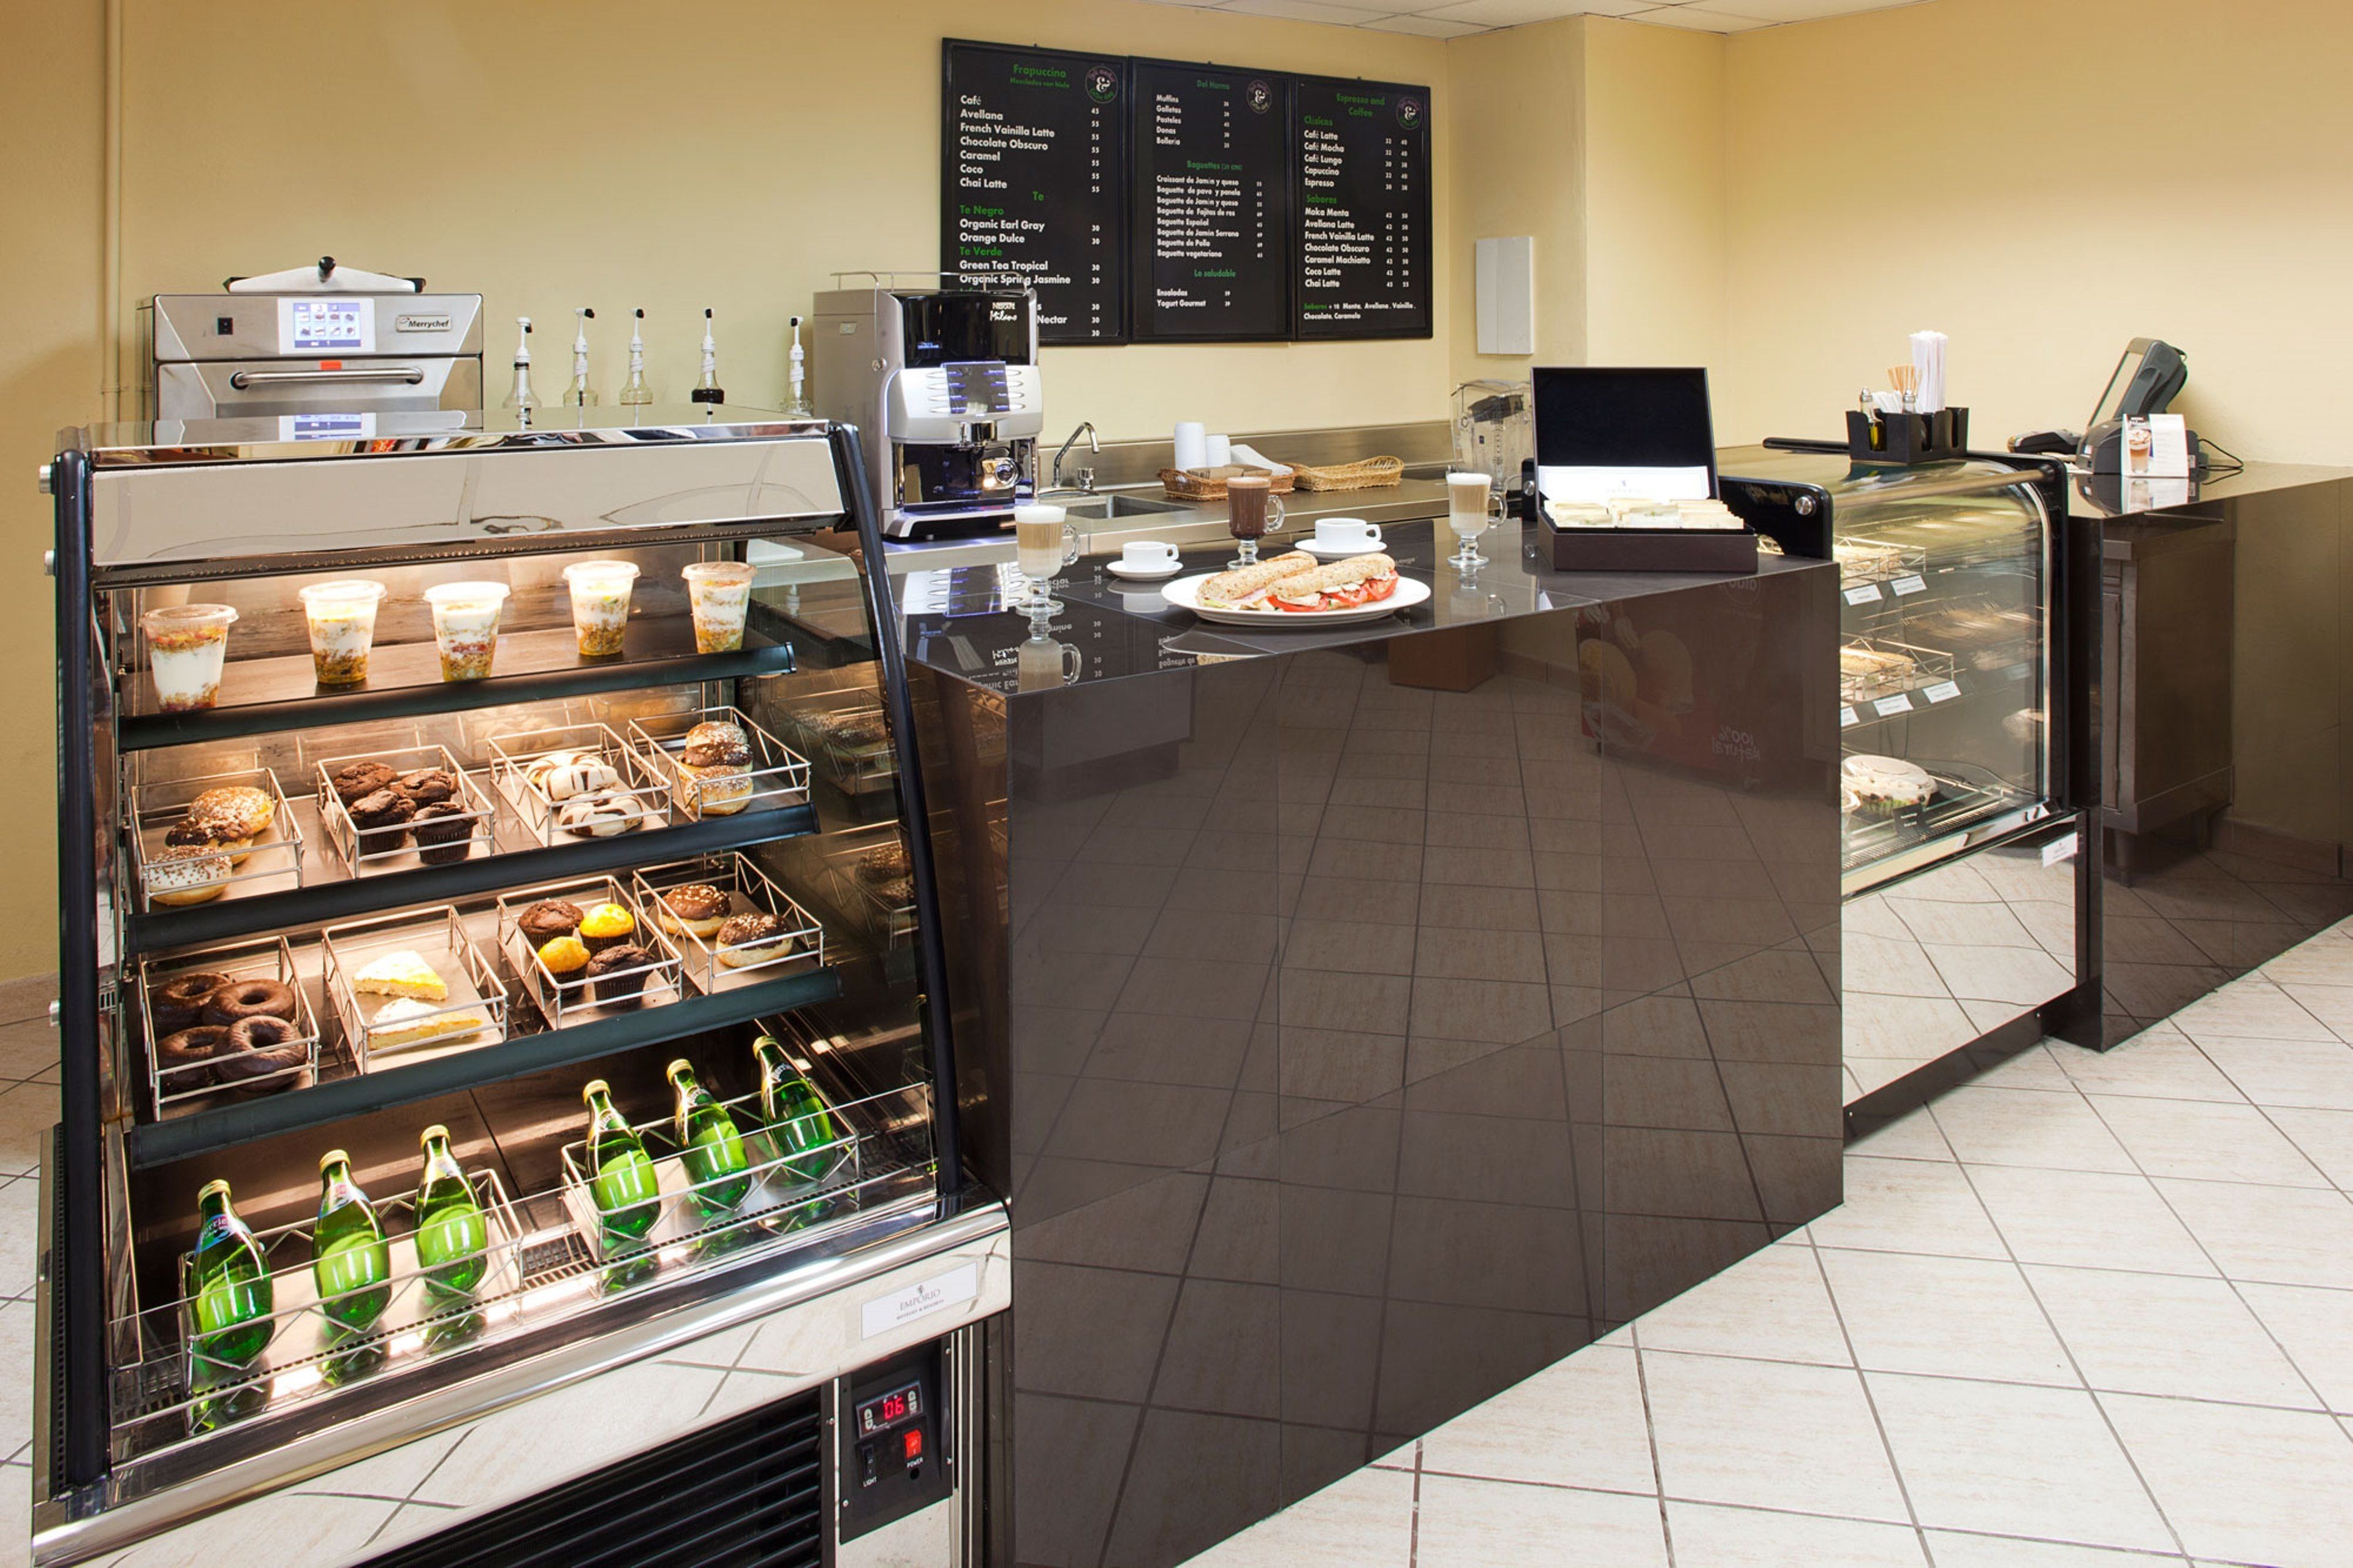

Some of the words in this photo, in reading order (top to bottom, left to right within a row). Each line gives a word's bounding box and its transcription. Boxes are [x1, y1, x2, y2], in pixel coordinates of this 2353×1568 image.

[1013, 64, 1066, 78] Frapuccino
[960, 108, 1003, 120] Avellana
[1156, 105, 1181, 113] Galletas
[1156, 115, 1181, 124] Pasteles
[961, 123, 991, 133] French
[994, 124, 1029, 135] Vainilla
[1033, 127, 1055, 137] Latte
[1320, 131, 1338, 140] Latte
[960, 136, 1007, 148] Chocolate
[1009, 139, 1048, 150] Obscuro
[1320, 143, 1344, 153] Mocha
[960, 150, 1000, 161] Caramel
[1320, 155, 1342, 165] Lungo
[960, 164, 983, 174] Coco
[1305, 165, 1339, 176] Capuccino
[960, 177, 981, 187] Chai
[984, 178, 1007, 188] Latte
[1157, 175, 1185, 184] Croissant
[1305, 177, 1334, 188] Espresso
[1157, 186, 1184, 194] Baguette
[1033, 191, 1044, 200] Te
[1306, 194, 1336, 203] Sabores
[1157, 196, 1184, 207] Baguette
[960, 205, 971, 214] Te
[974, 206, 1004, 216] Negro
[1157, 206, 1184, 215] Baguette
[1305, 207, 1325, 216] Moka
[960, 218, 998, 230] Organic
[1001, 219, 1018, 229] Earl
[1021, 221, 1045, 232] Gray
[1157, 218, 1184, 227] Baguette
[1305, 219, 1336, 228] Avellana
[1158, 228, 1184, 237] Baguette
[1305, 231, 1327, 240] French
[1329, 232, 1355, 240] Vainilla
[960, 232, 996, 244] Orange
[999, 233, 1025, 243] Dulce
[1158, 238, 1184, 247] Baguette
[960, 246, 971, 255] Te
[973, 247, 1002, 256] Verde
[1305, 243, 1339, 252] Chocolate
[1341, 243, 1370, 252] Obscuro
[1158, 249, 1184, 259] Baguette
[1305, 255, 1335, 263] Caramel
[960, 260, 990, 270] Green
[991, 260, 1009, 270] Tea
[1010, 260, 1048, 272] Tropical
[960, 275, 998, 286] Organic
[1033, 275, 1070, 284] Jasmine
[1305, 279, 1321, 287] Chai
[1157, 300, 1178, 308] Yogurt
[409, 320, 449, 328] Merrychef
[1037, 316, 1067, 324] Nectar
[900, 1289, 941, 1311] EMPORIO
[883, 1396, 904, 1420] 06
[907, 1458, 923, 1468] POWER
[863, 1476, 877, 1487] LIGHT
